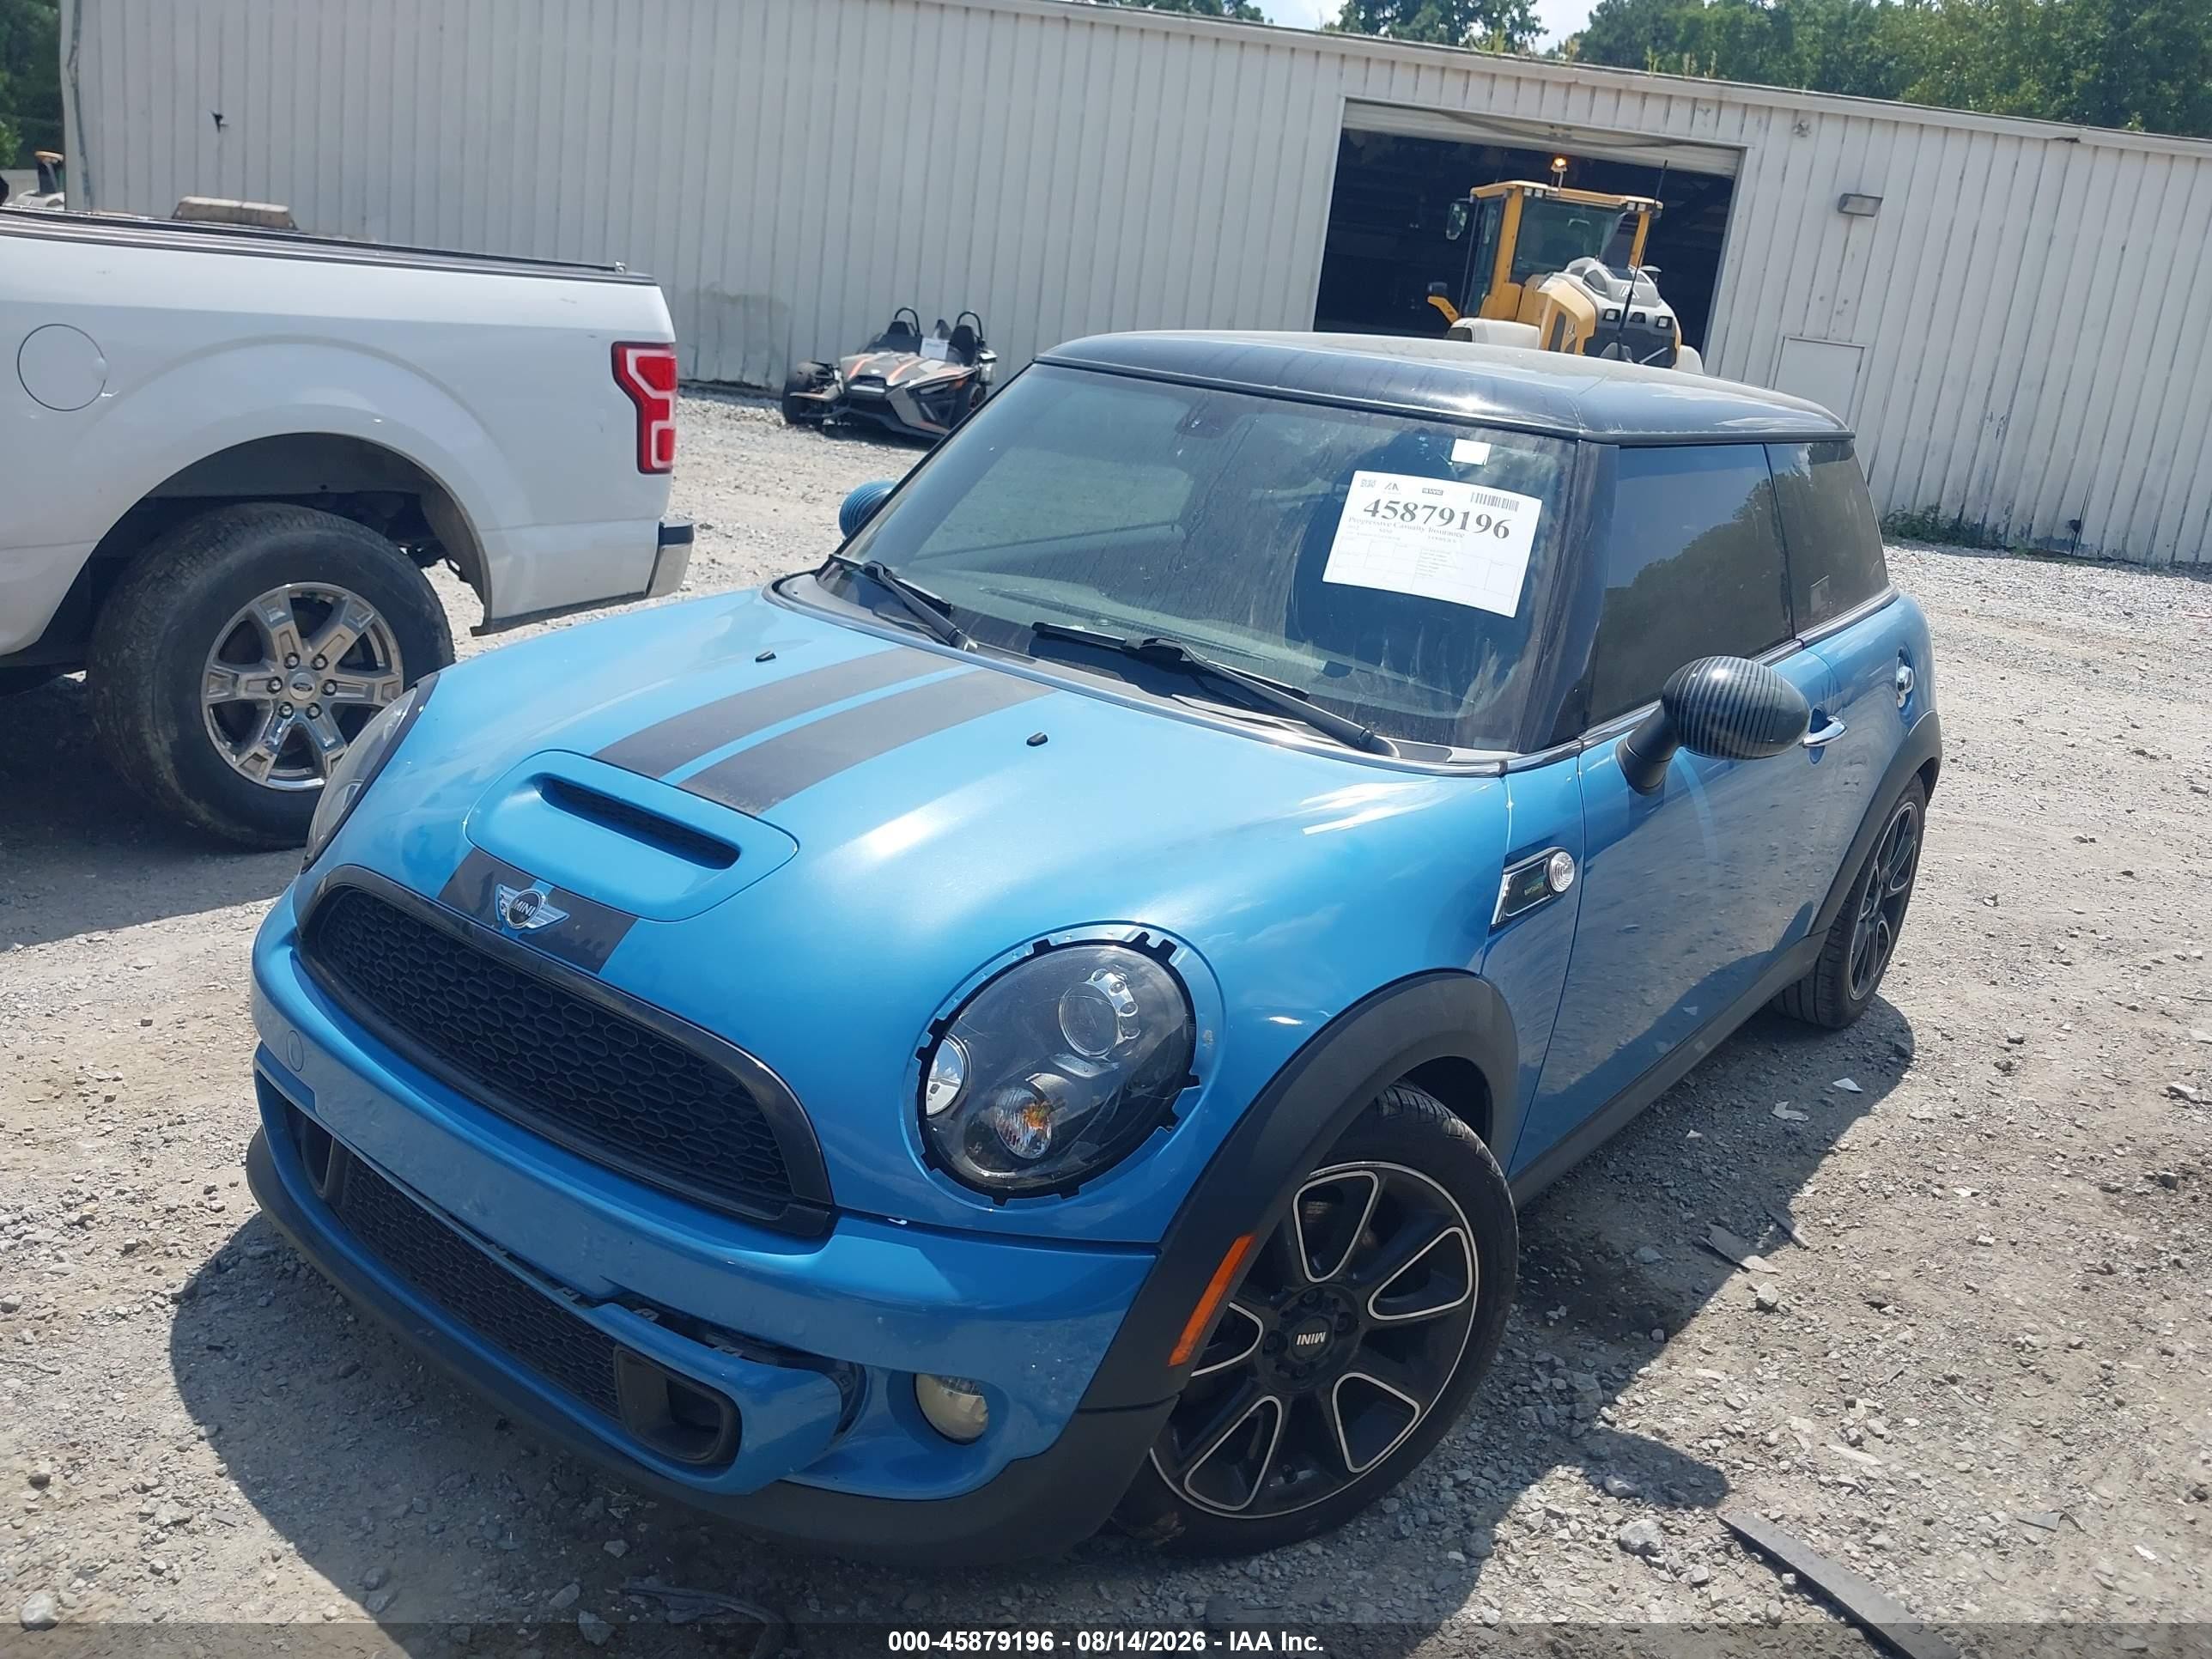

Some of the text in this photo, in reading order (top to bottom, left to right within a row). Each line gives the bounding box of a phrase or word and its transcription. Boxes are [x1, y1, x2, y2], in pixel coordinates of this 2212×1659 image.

[1348, 515, 1465, 538] Progressive Casualty Insurance
[1363, 498, 1513, 540] 45879196
[513, 899, 537, 917] MINI
[1296, 1331, 1327, 1346] MINI
